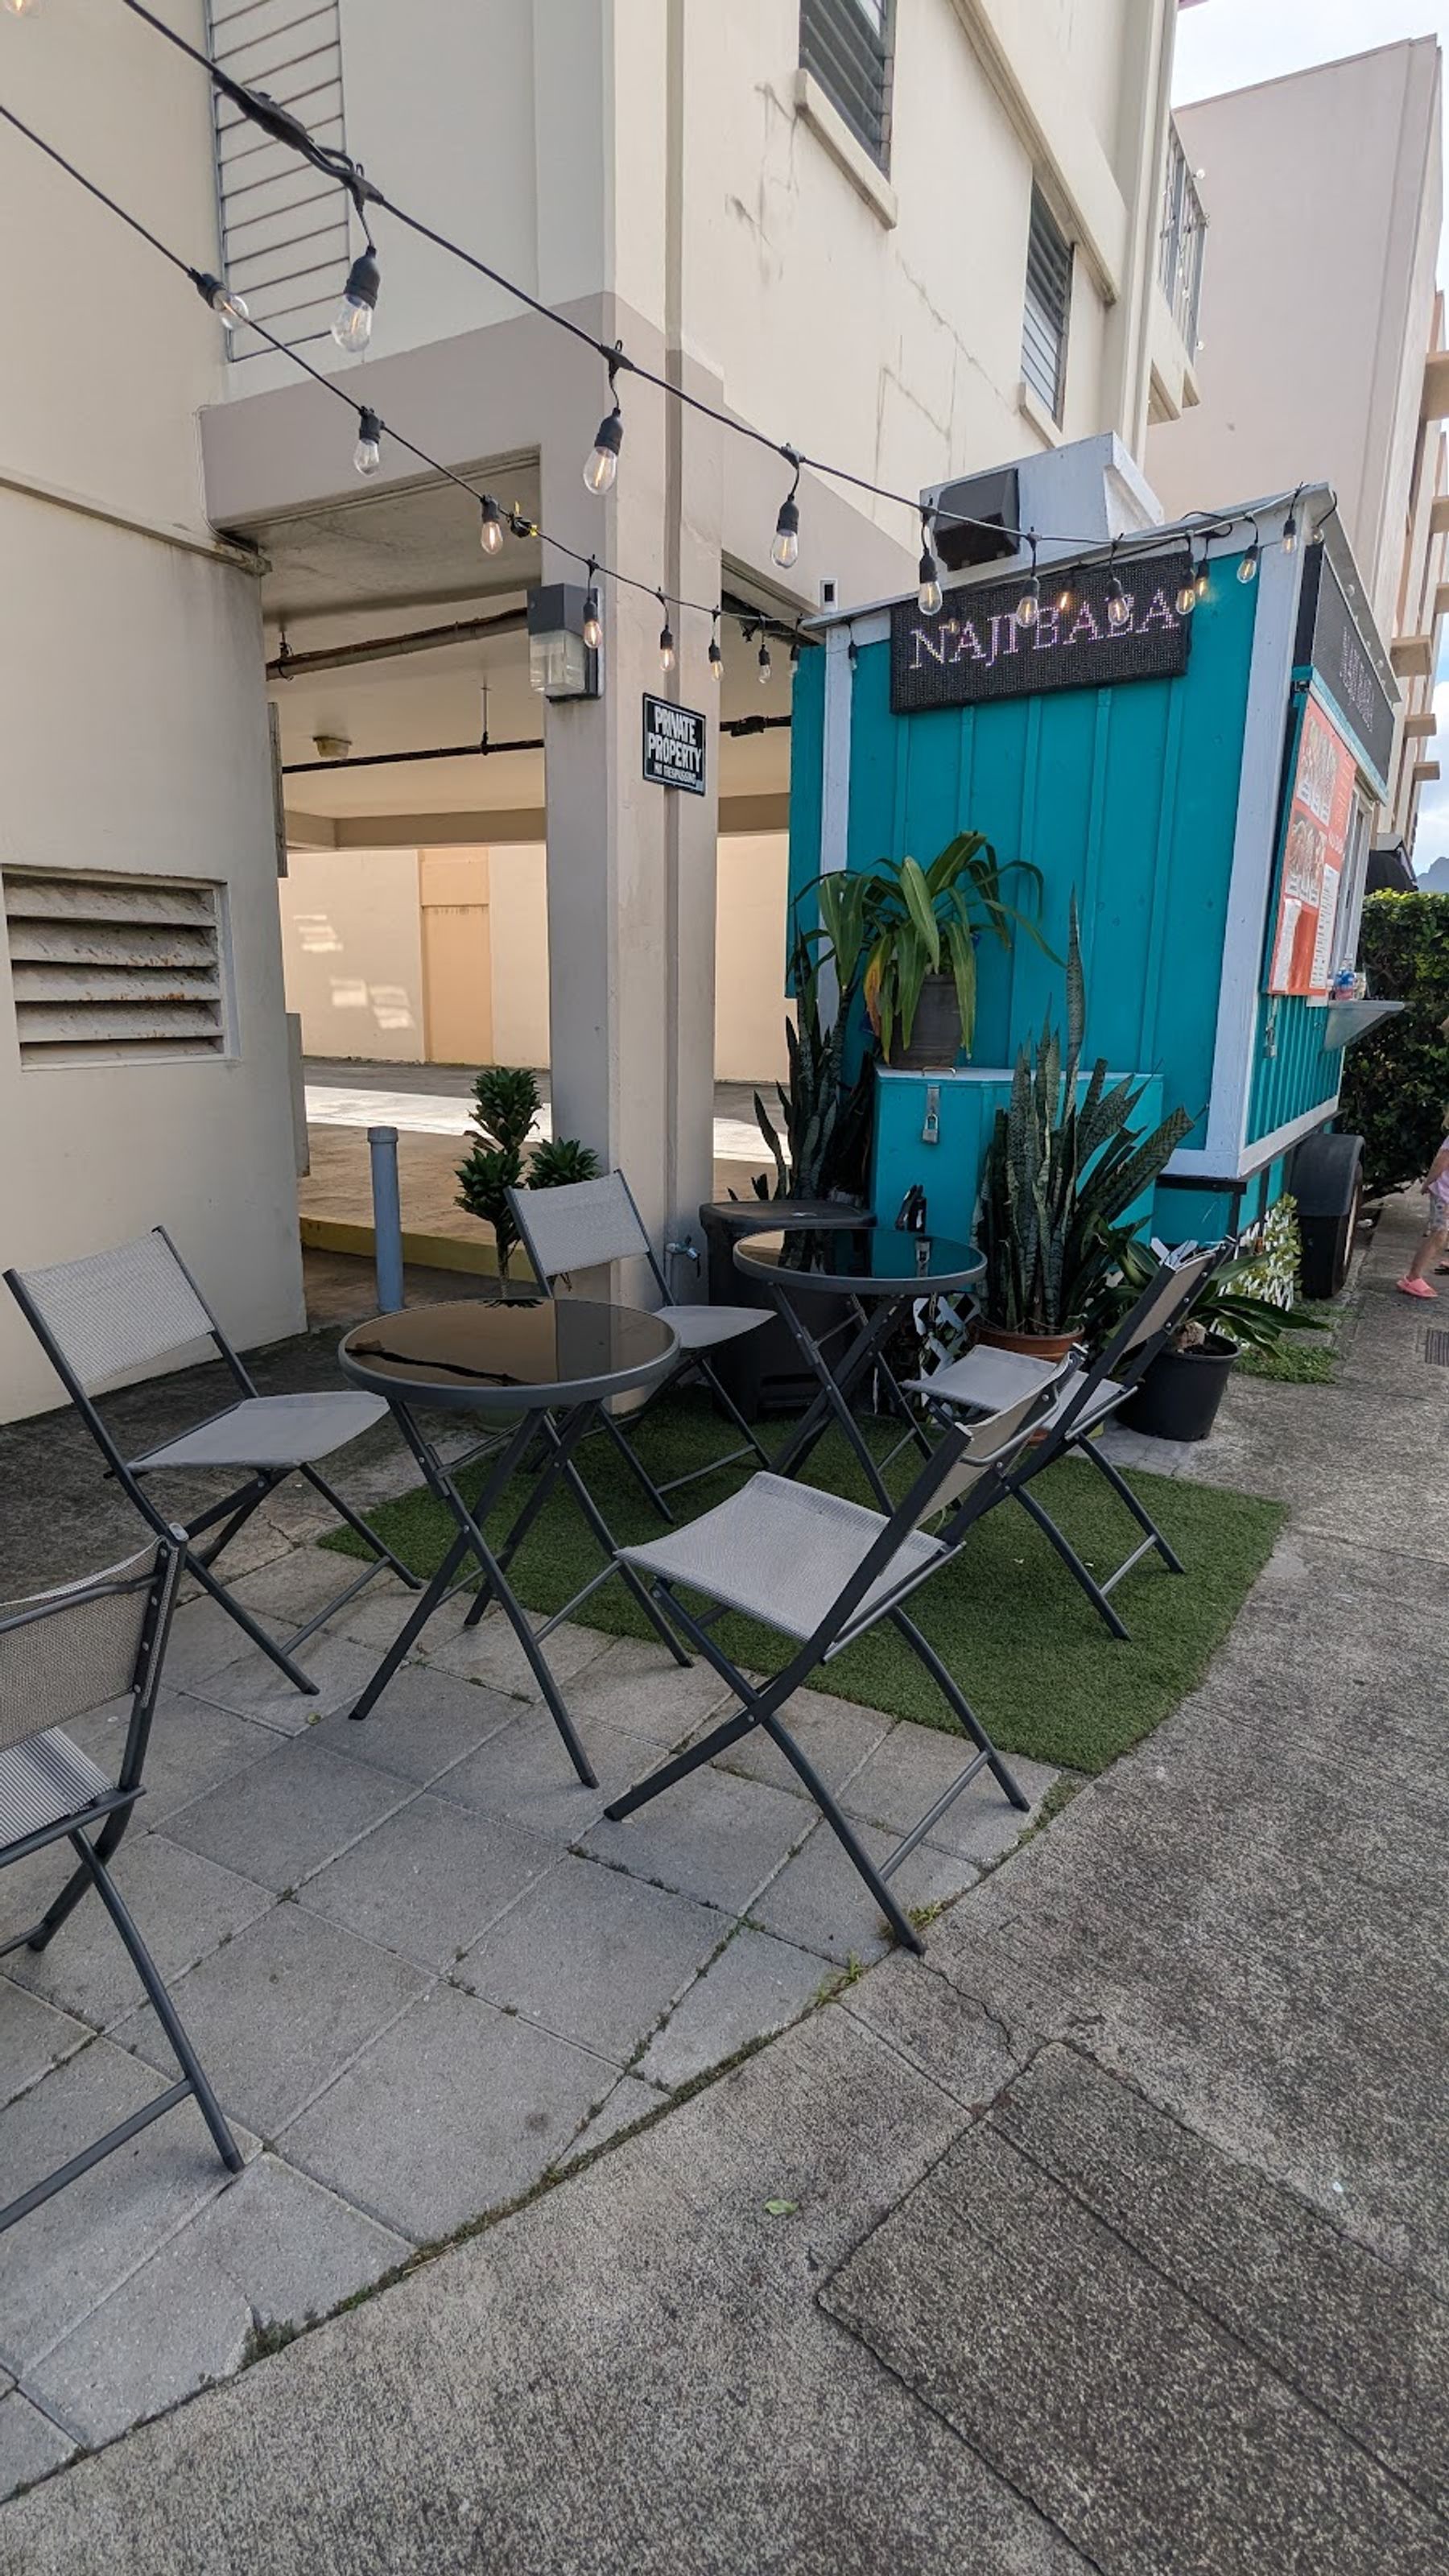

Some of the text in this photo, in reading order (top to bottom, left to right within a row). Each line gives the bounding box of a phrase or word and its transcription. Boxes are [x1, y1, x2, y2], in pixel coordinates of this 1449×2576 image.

[908, 588, 1180, 670] NAJI BABA
[654, 705, 696, 745] PRIVATE
[648, 732, 702, 773] PROPERTY
